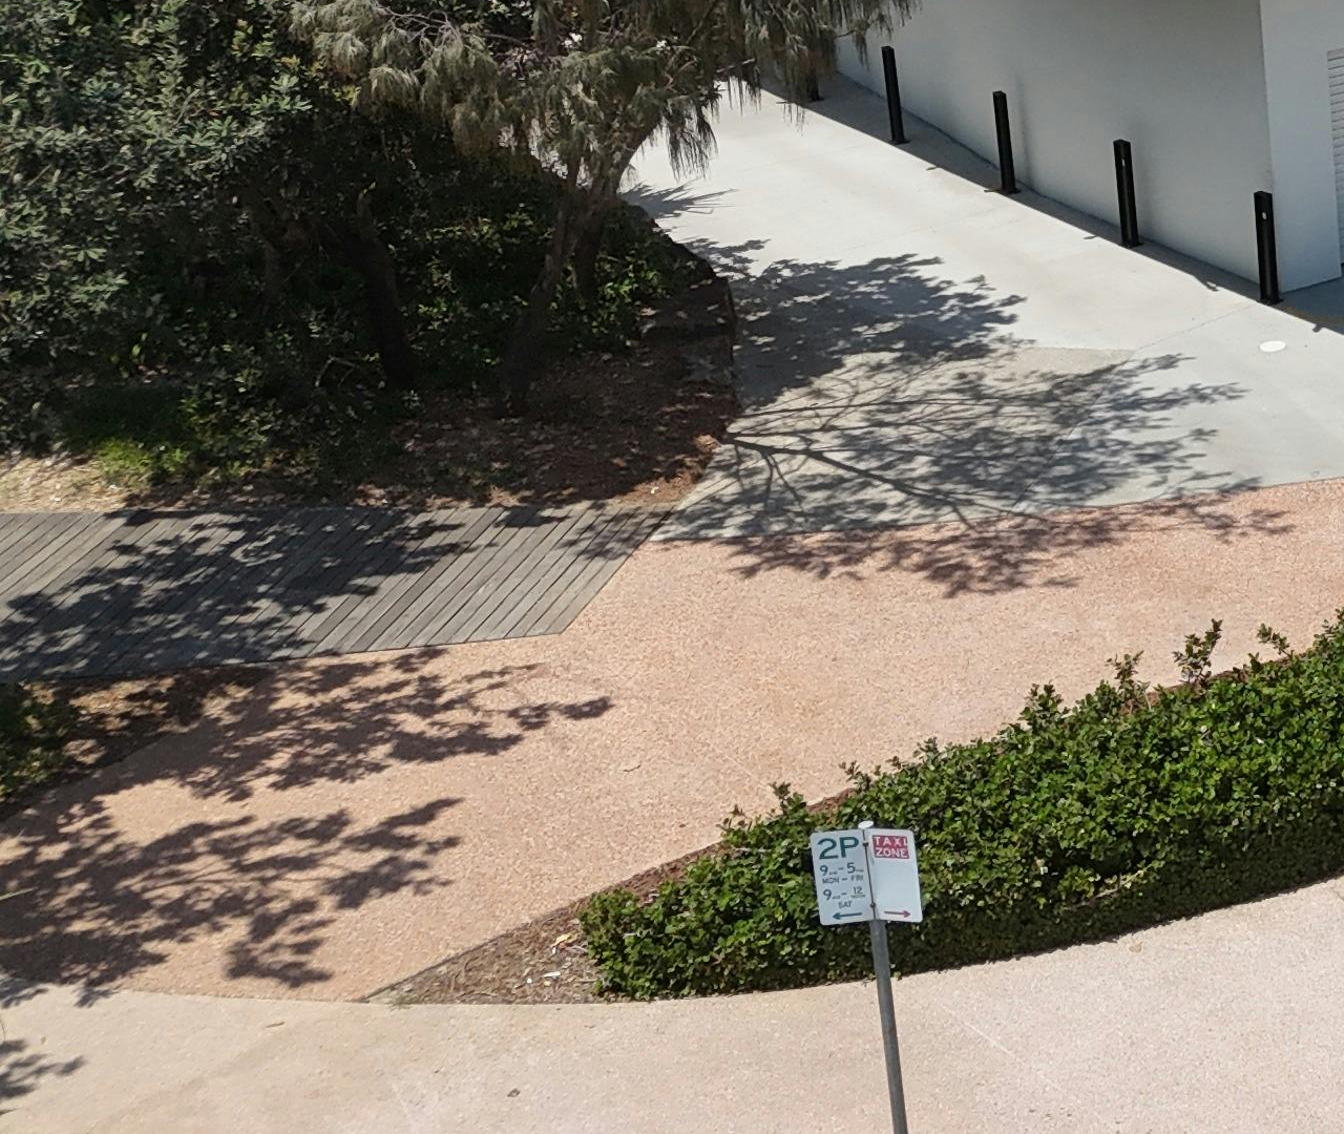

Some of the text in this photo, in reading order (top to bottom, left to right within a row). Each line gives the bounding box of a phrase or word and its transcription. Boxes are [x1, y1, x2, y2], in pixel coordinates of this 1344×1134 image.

[873, 836, 907, 847] TAXI
[817, 836, 860, 860] 2P
[875, 847, 908, 858] ZONE
